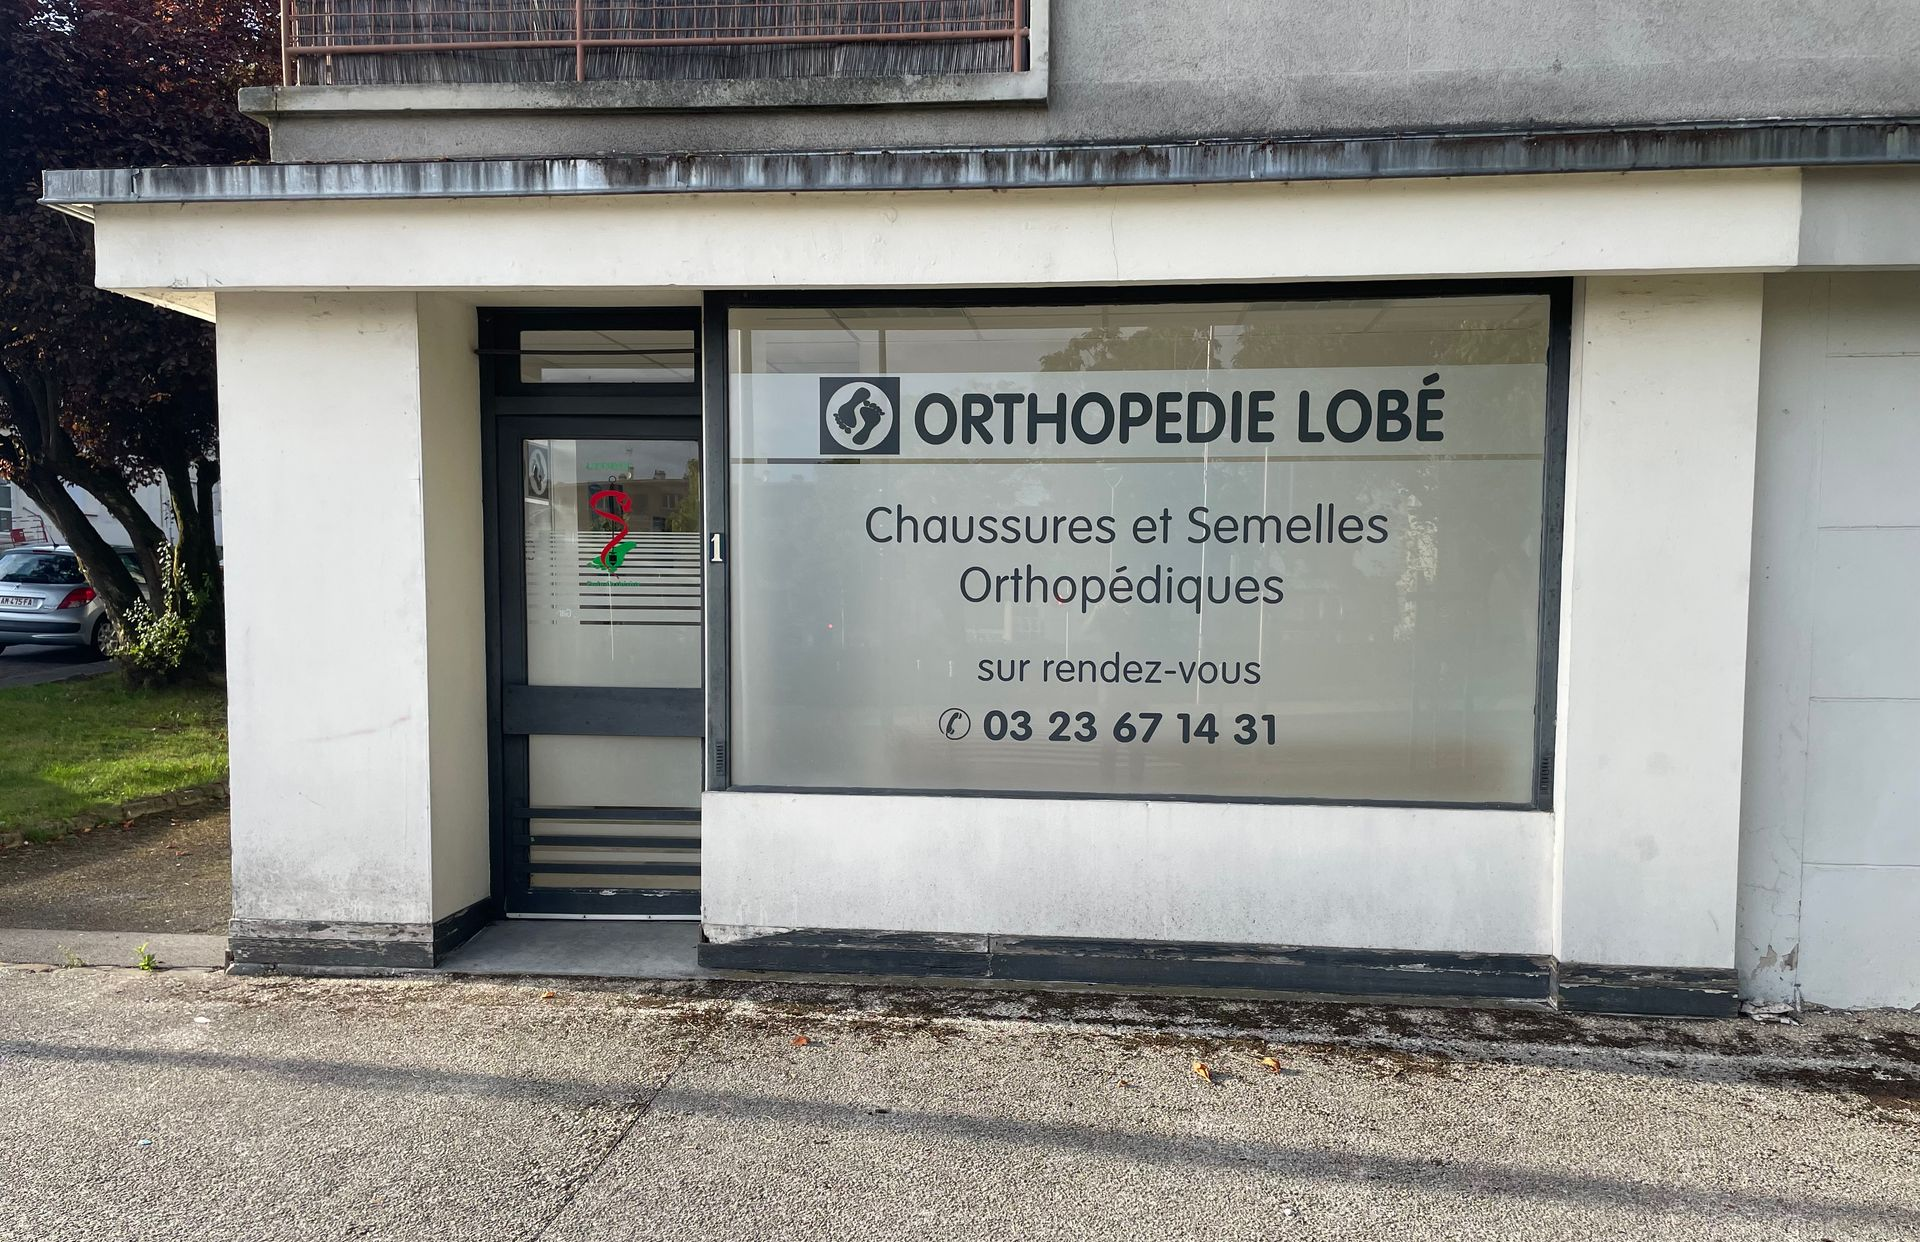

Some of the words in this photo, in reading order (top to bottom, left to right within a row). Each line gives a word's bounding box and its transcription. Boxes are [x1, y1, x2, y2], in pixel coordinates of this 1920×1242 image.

[915, 391, 1276, 445] ORTHOPEDIE
[1298, 373, 1446, 443] LOBÉ
[866, 504, 1116, 544] Chaussures
[1133, 507, 1173, 544] et
[1187, 503, 1389, 544] Semelles
[710, 533, 723, 562] 1
[960, 564, 1284, 613] Orthopédiques
[977, 659, 1031, 682] sur
[1043, 652, 1261, 685] rendez-vous
[983, 710, 1033, 742] 03
[1048, 711, 1098, 743] 23
[1112, 711, 1162, 744] 67
[1176, 713, 1220, 745] 14
[1233, 714, 1276, 746] 31
